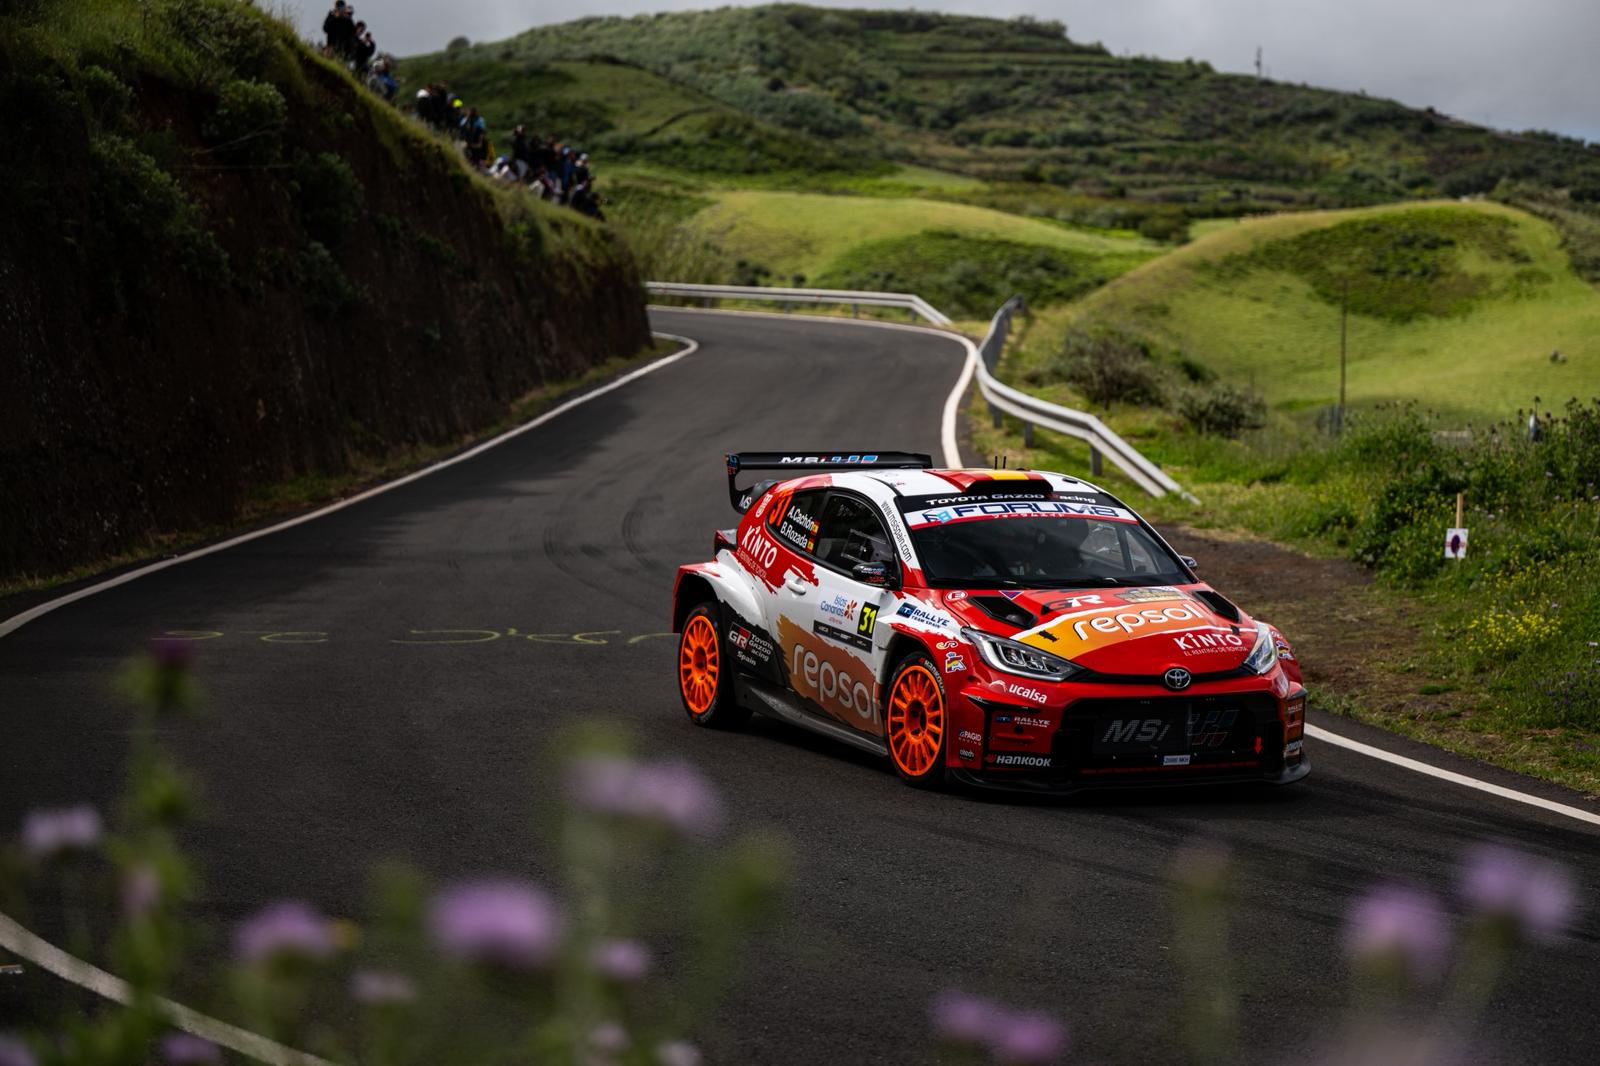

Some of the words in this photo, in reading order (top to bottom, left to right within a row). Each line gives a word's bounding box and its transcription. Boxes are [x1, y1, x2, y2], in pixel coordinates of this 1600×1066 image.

[769, 488, 794, 526] 31
[926, 494, 987, 505] TOYOTA
[953, 502, 1119, 517] FORUM8
[787, 505, 815, 532] A.Cachón
[780, 521, 808, 549] B.Rozada
[881, 501, 912, 562] www.msispain.com
[820, 600, 844, 617] Canarias
[834, 594, 847, 607] Islas
[859, 606, 877, 634] 31
[911, 615, 930, 623] TEAM
[930, 620, 945, 628] SPAIN
[913, 609, 955, 627] RALLYE
[1073, 603, 1203, 641] repsol
[729, 630, 747, 649] GR
[749, 639, 771, 655] GAZOO
[751, 634, 774, 650] TOYOTA
[737, 651, 756, 666] Spain
[794, 644, 878, 724] repsol
[1008, 683, 1047, 704] ucalsa
[1014, 716, 1051, 725] RALLYE
[964, 730, 982, 742] PAGID
